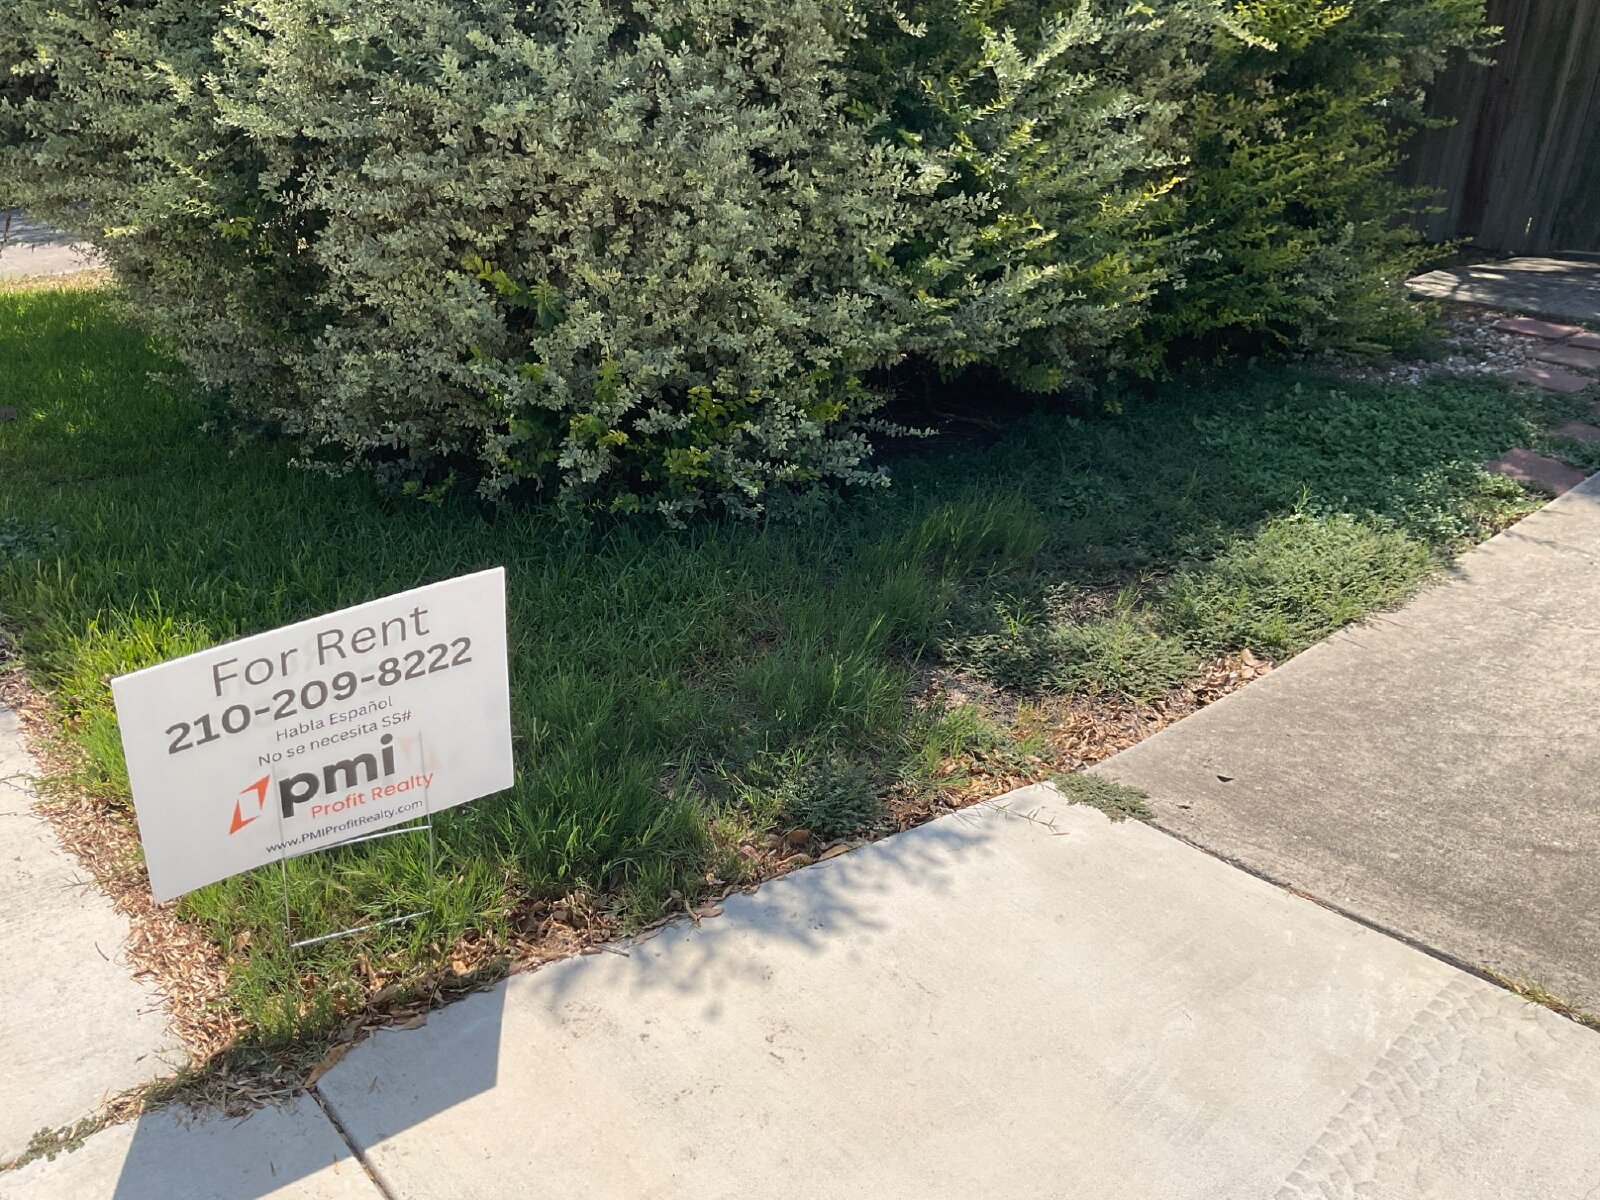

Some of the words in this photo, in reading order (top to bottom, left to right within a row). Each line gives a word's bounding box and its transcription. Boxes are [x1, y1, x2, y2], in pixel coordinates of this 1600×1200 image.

[212, 647, 297, 696] For
[317, 606, 430, 665] Rent
[165, 637, 472, 755] 210-209-8222
[276, 717, 325, 742] Habla
[330, 695, 393, 725] Español
[258, 749, 282, 767] No
[286, 743, 306, 758] se
[310, 722, 377, 750] necesita
[381, 710, 412, 728] SS#
[279, 734, 395, 818] pmi
[311, 791, 366, 819] Profit
[371, 772, 433, 801] Realty
[265, 799, 424, 854] www.PMIProfitRealty.com
